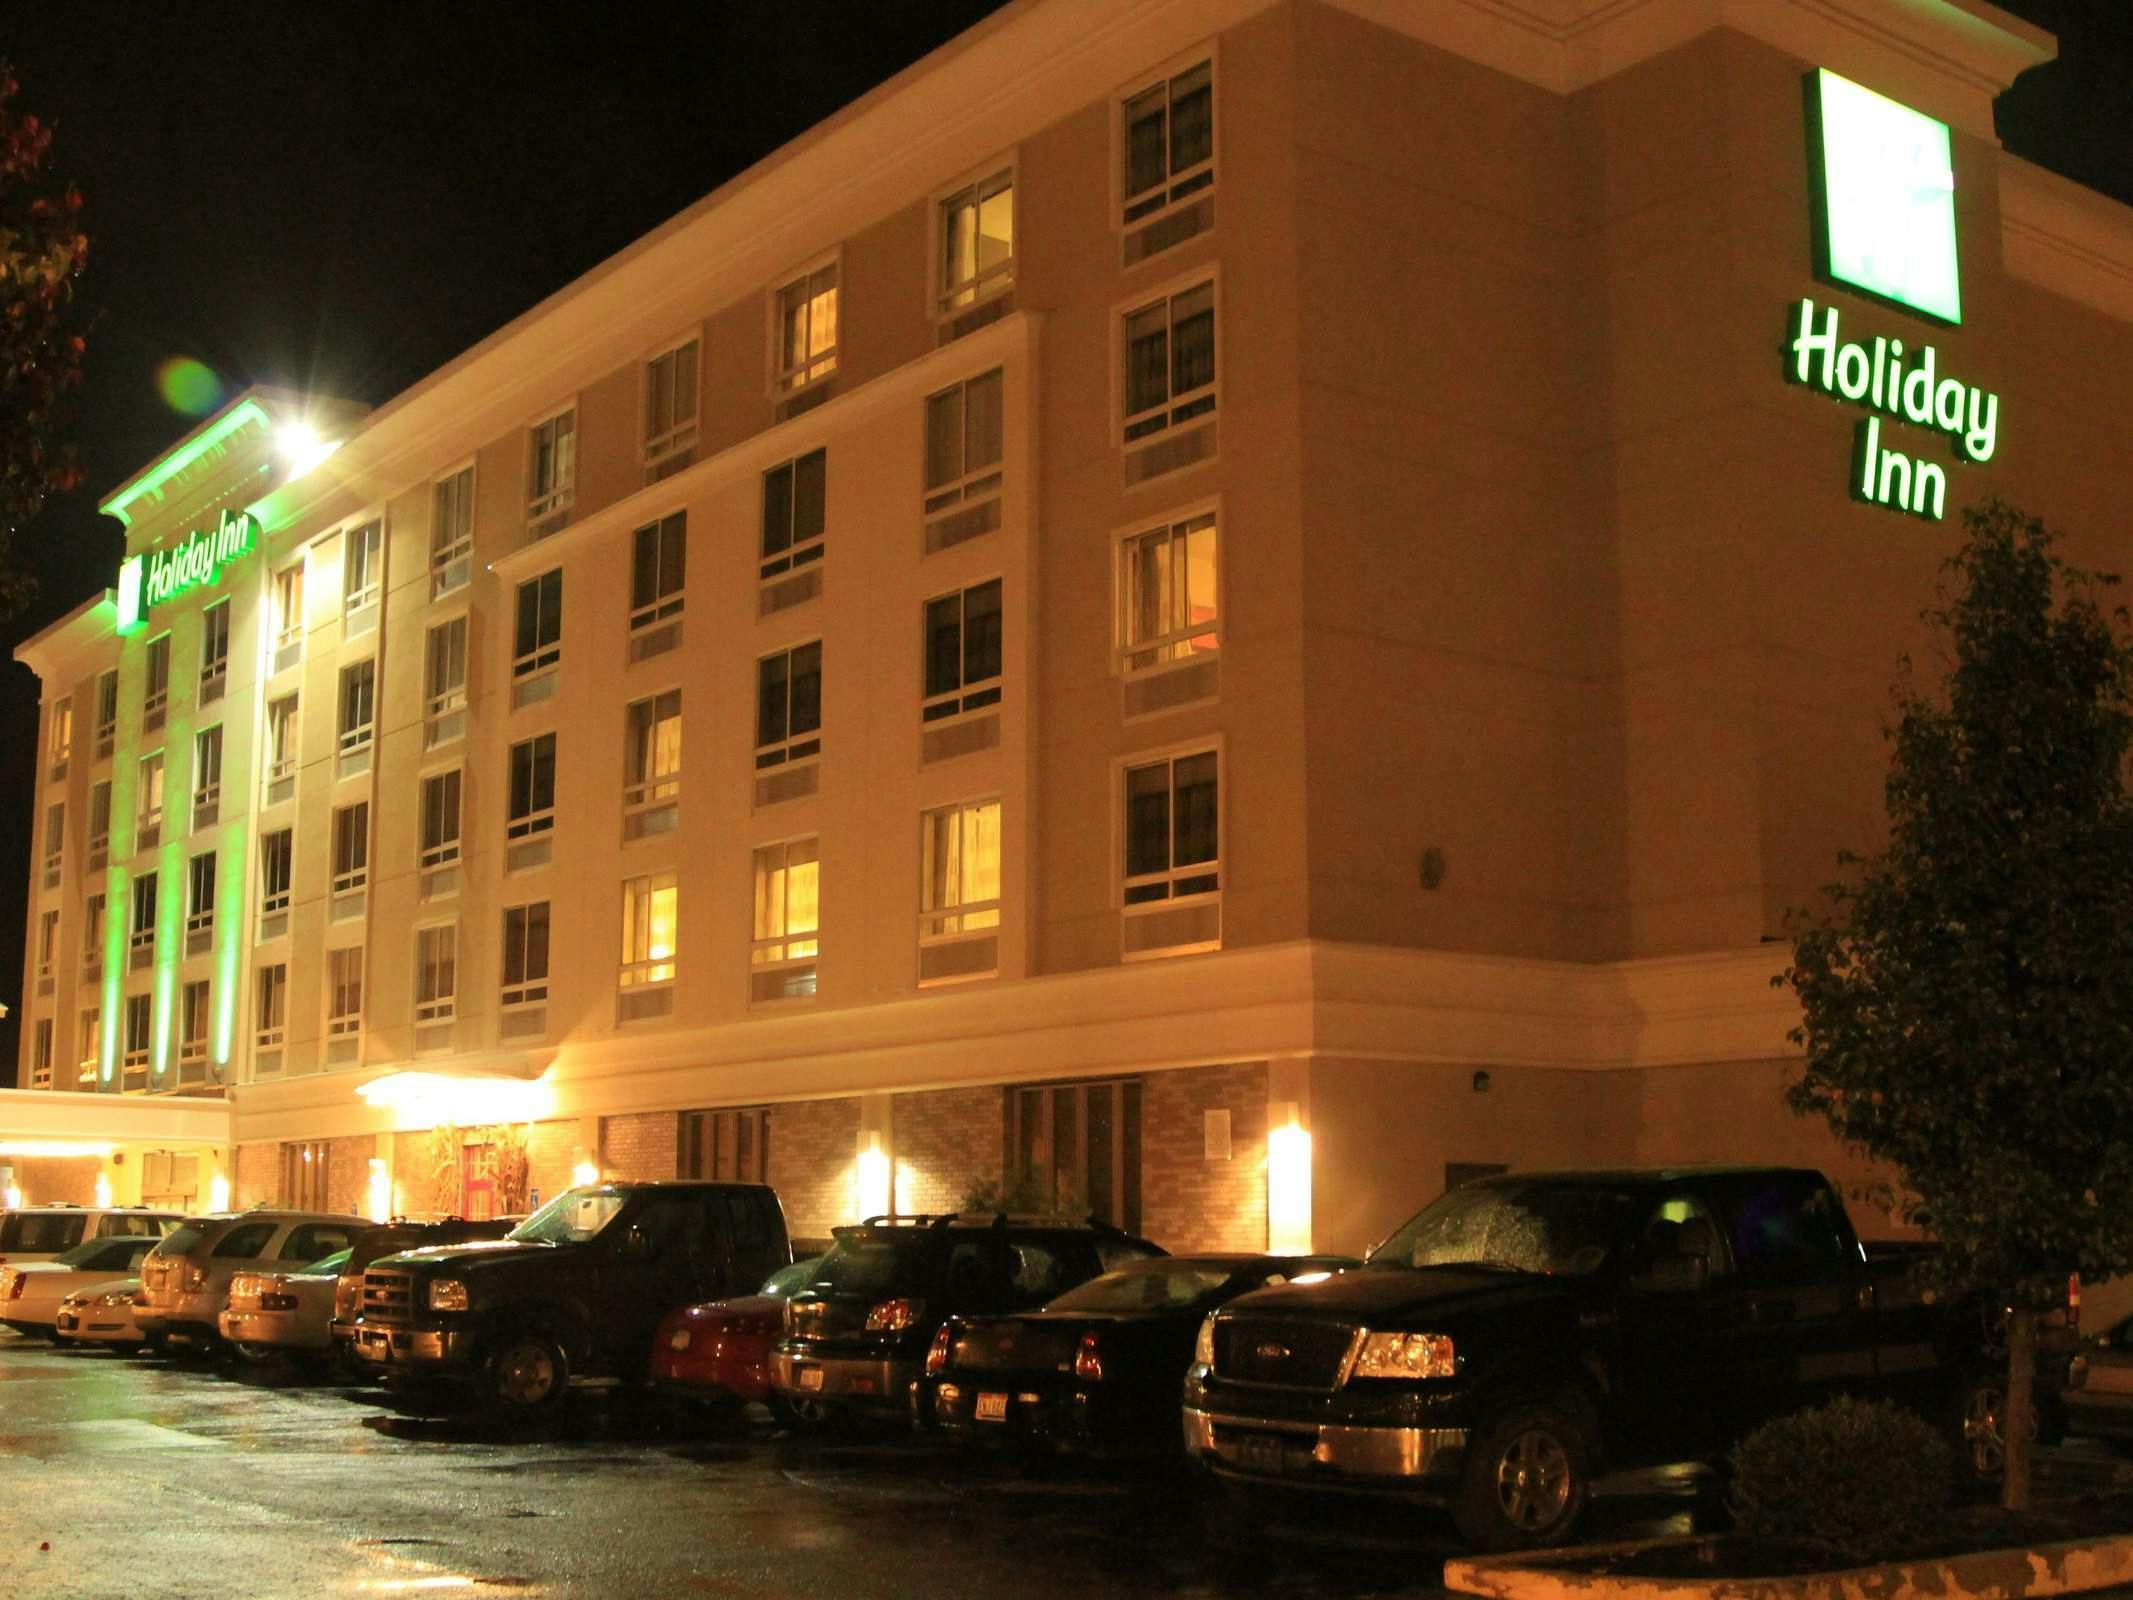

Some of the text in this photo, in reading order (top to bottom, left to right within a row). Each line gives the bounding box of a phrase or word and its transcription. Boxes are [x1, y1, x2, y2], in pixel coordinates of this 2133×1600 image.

[1793, 298, 1998, 462] Holiday
[1862, 416, 1946, 519] Inn
[147, 508, 249, 607] Holiday Inn
